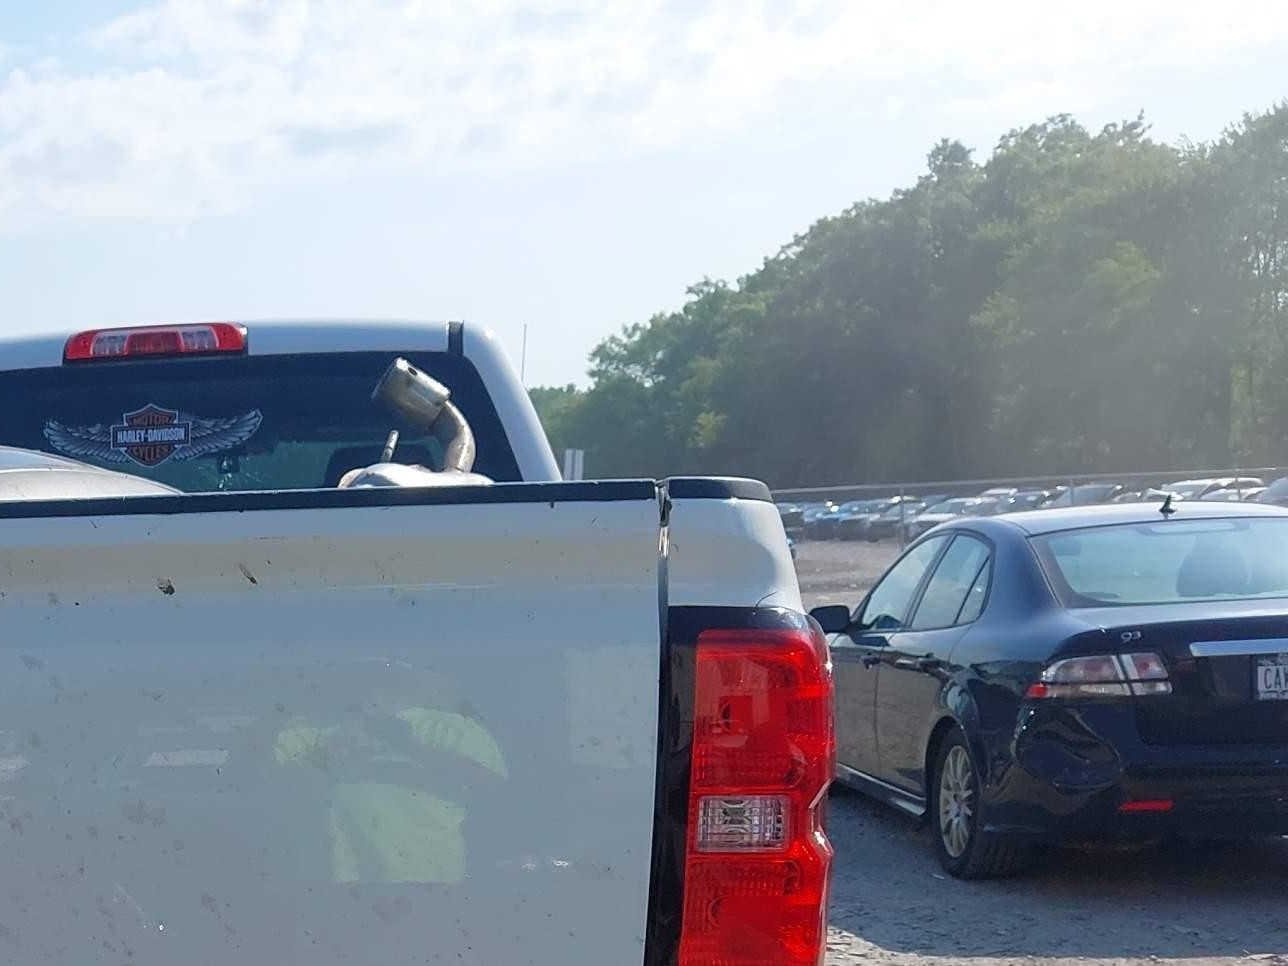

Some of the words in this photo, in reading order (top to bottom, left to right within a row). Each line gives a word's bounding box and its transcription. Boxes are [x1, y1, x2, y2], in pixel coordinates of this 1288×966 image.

[132, 414, 170, 426] MOTOR
[117, 427, 185, 443] HARLEY-DAVIDSON
[132, 445, 169, 461] CYCLES
